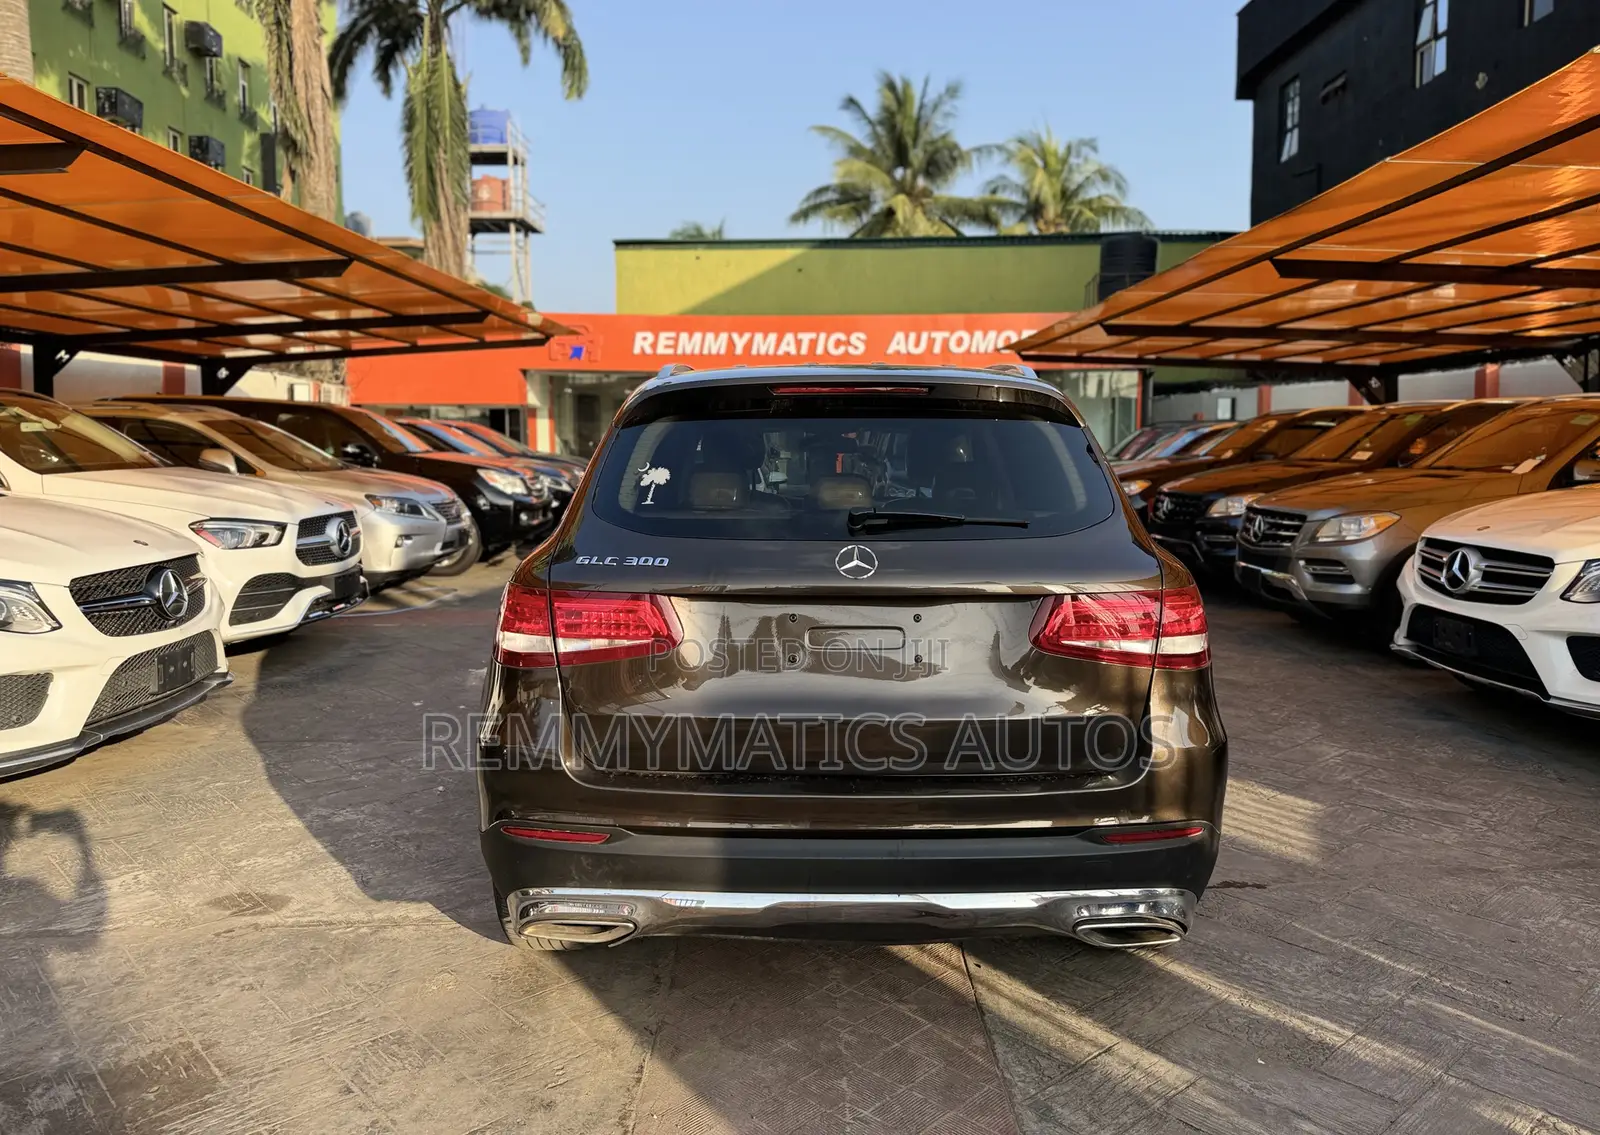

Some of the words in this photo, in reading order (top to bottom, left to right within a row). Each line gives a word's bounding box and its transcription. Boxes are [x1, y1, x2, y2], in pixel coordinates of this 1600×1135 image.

[633, 331, 867, 356] REMMYMATICS
[886, 329, 1038, 355] AUTOMO
[575, 555, 620, 566] GLC
[623, 556, 670, 567] 300
